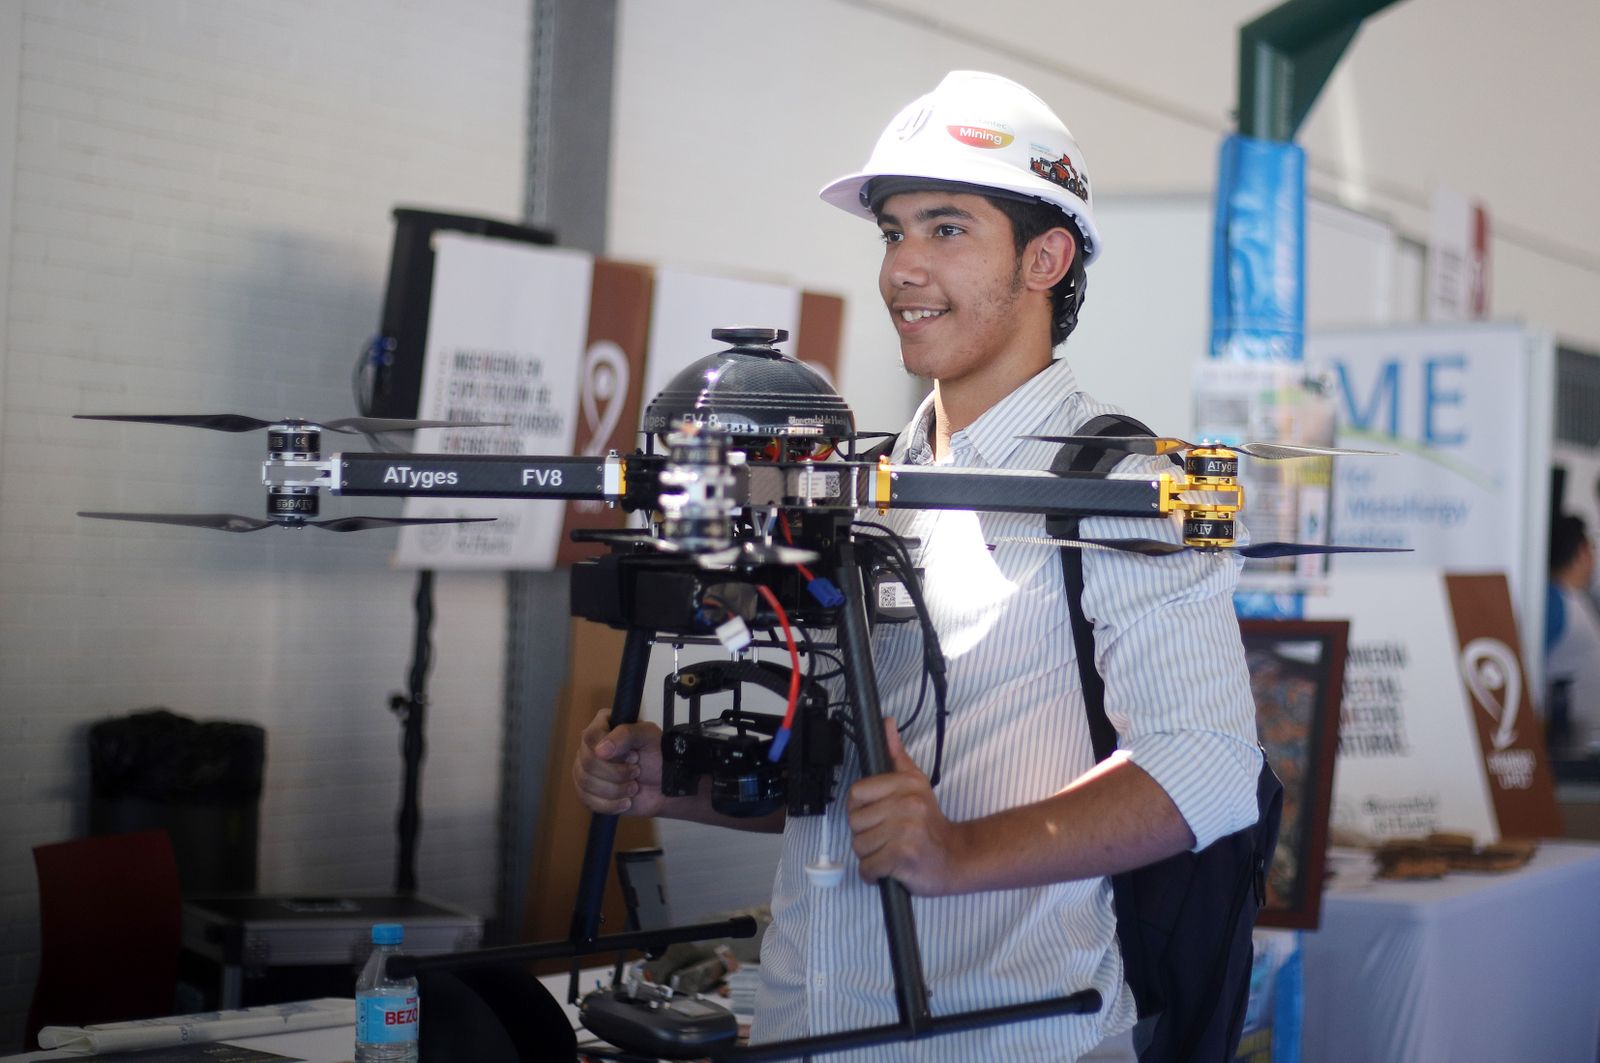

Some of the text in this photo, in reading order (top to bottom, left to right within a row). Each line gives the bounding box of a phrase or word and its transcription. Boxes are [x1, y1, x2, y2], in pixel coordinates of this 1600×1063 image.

[959, 127, 1002, 145] Mining
[383, 466, 563, 488] ATyges FV8
[385, 1008, 418, 1025] BEZO
